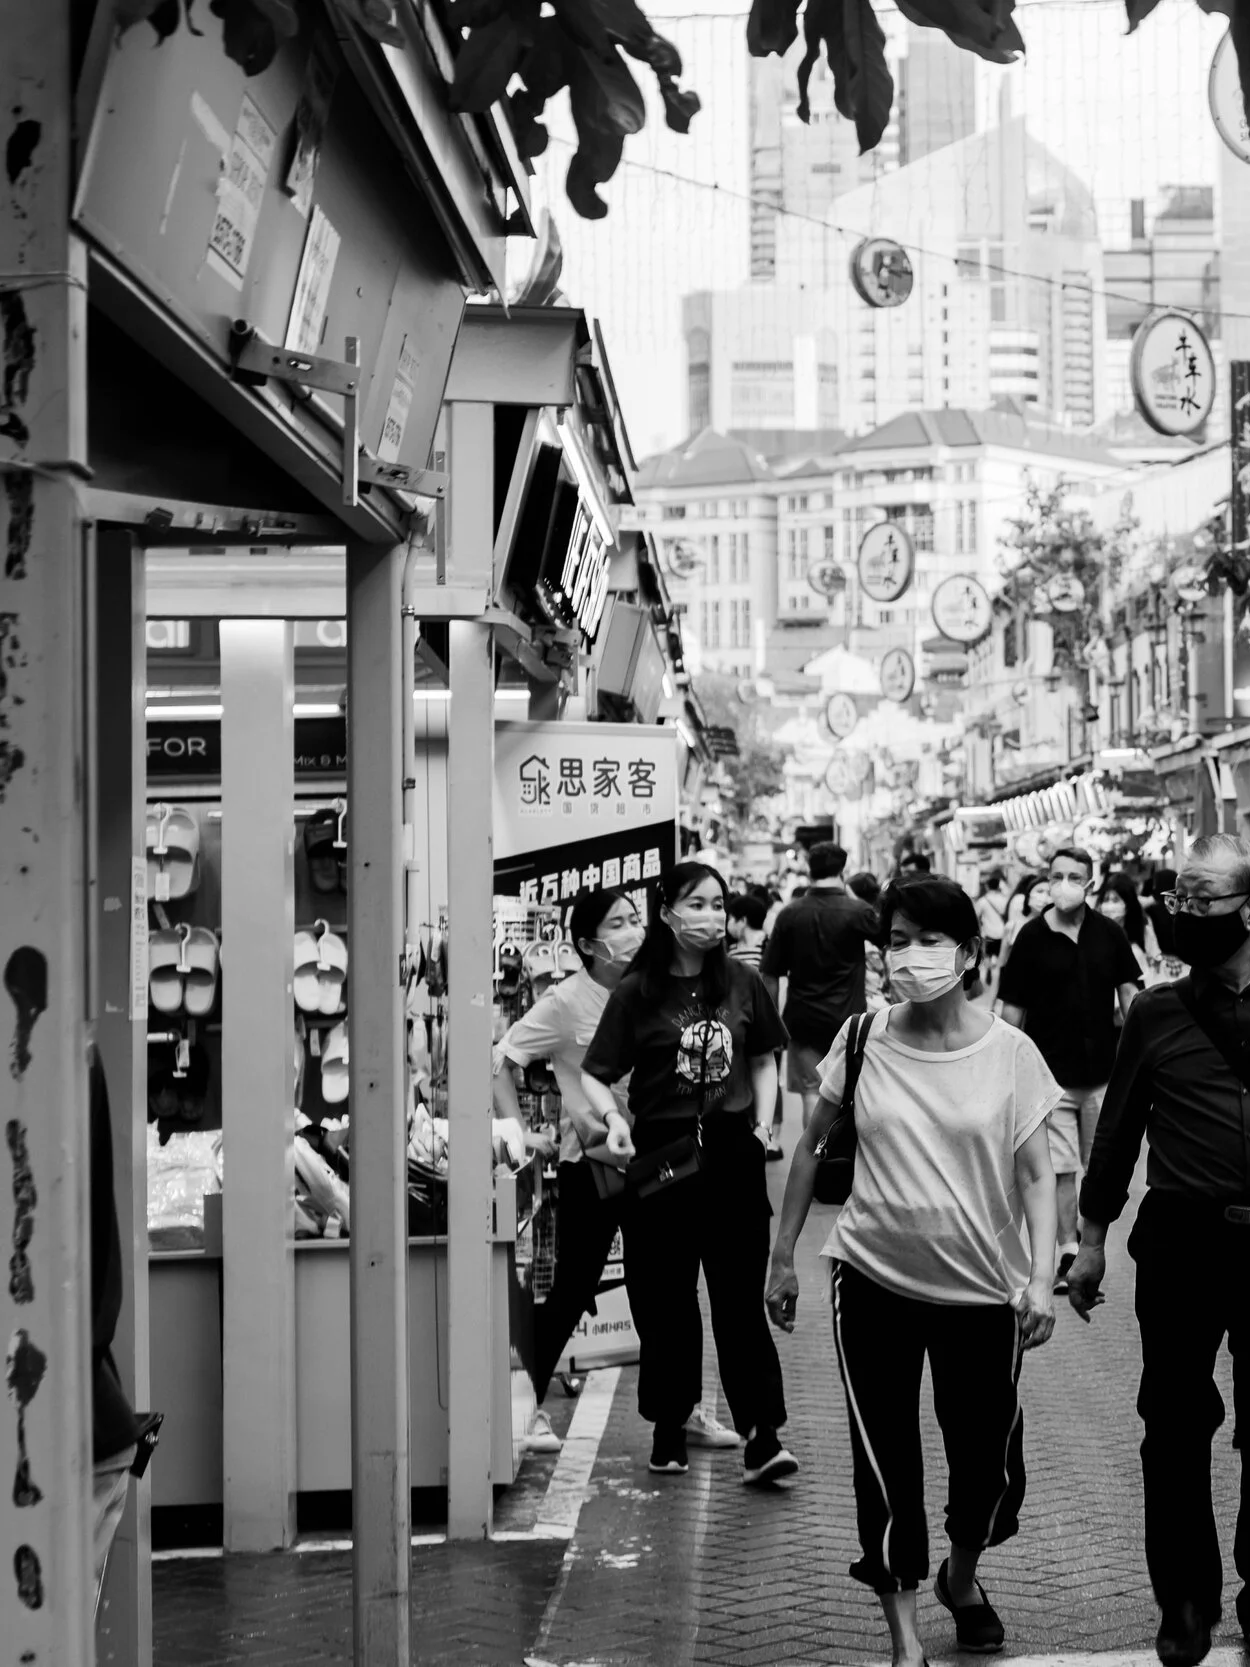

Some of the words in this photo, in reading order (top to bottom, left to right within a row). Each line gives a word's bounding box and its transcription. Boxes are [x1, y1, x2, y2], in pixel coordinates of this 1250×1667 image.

[146, 737, 206, 757] FOR
[557, 757, 656, 798] 思家客
[519, 848, 661, 905] 近万种中国商品
